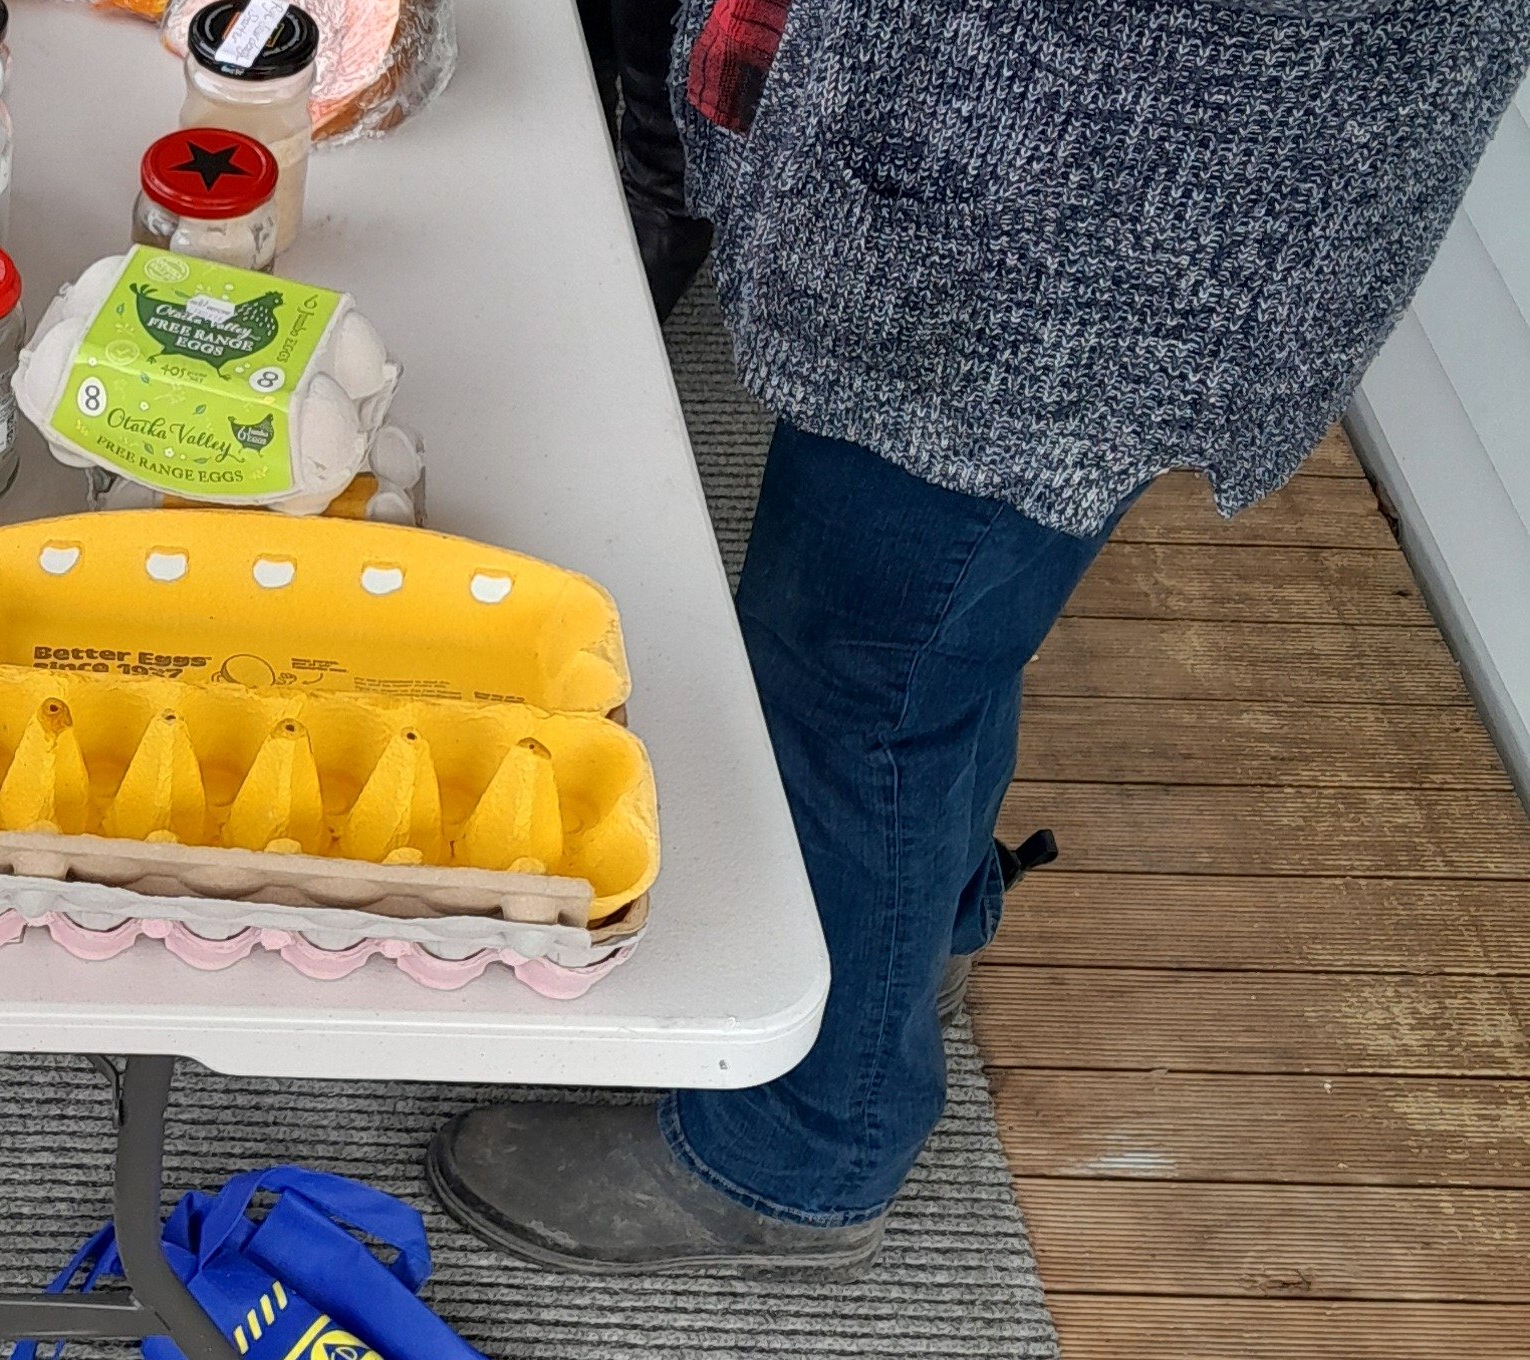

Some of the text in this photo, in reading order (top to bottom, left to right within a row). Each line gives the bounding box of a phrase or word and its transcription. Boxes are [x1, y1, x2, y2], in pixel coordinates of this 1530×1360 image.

[304, 294, 318, 309] 6
[148, 317, 254, 351] FREE RANGE
[175, 337, 224, 356] EGGS
[257, 371, 279, 388] 8
[85, 385, 101, 411] 8
[107, 407, 246, 463] Otaika Valley
[96, 435, 244, 483] FREE RANGE EGGS
[33, 646, 208, 667] Better Eggs
